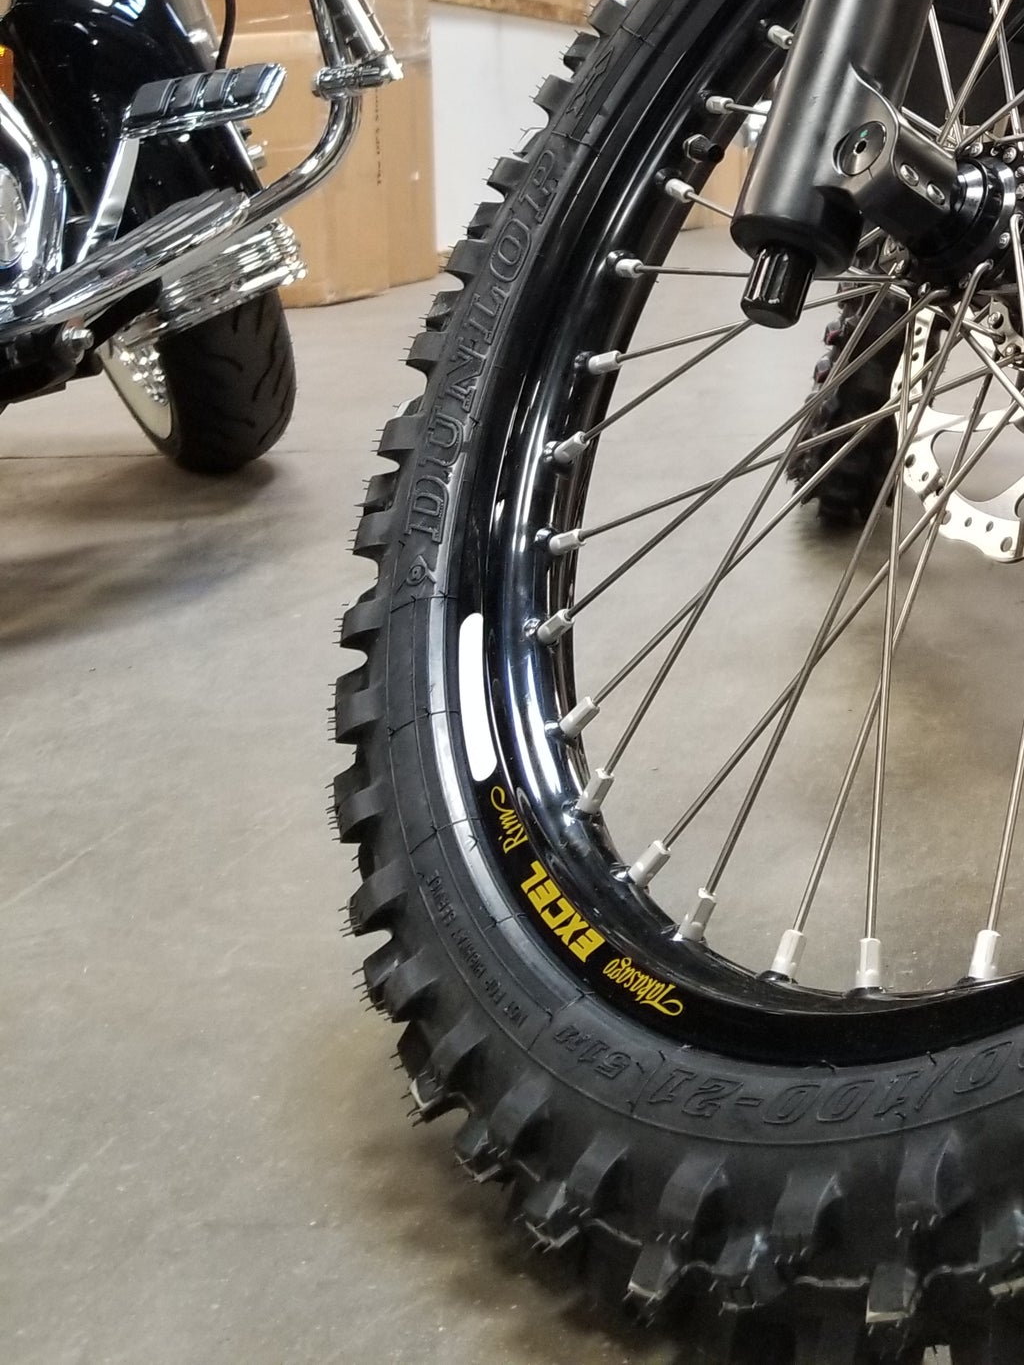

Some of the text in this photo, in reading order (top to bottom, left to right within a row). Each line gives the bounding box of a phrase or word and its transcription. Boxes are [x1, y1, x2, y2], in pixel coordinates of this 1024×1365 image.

[404, 149, 557, 544] DUNLOP
[489, 786, 683, 1017] Takasago EXCEL Rim
